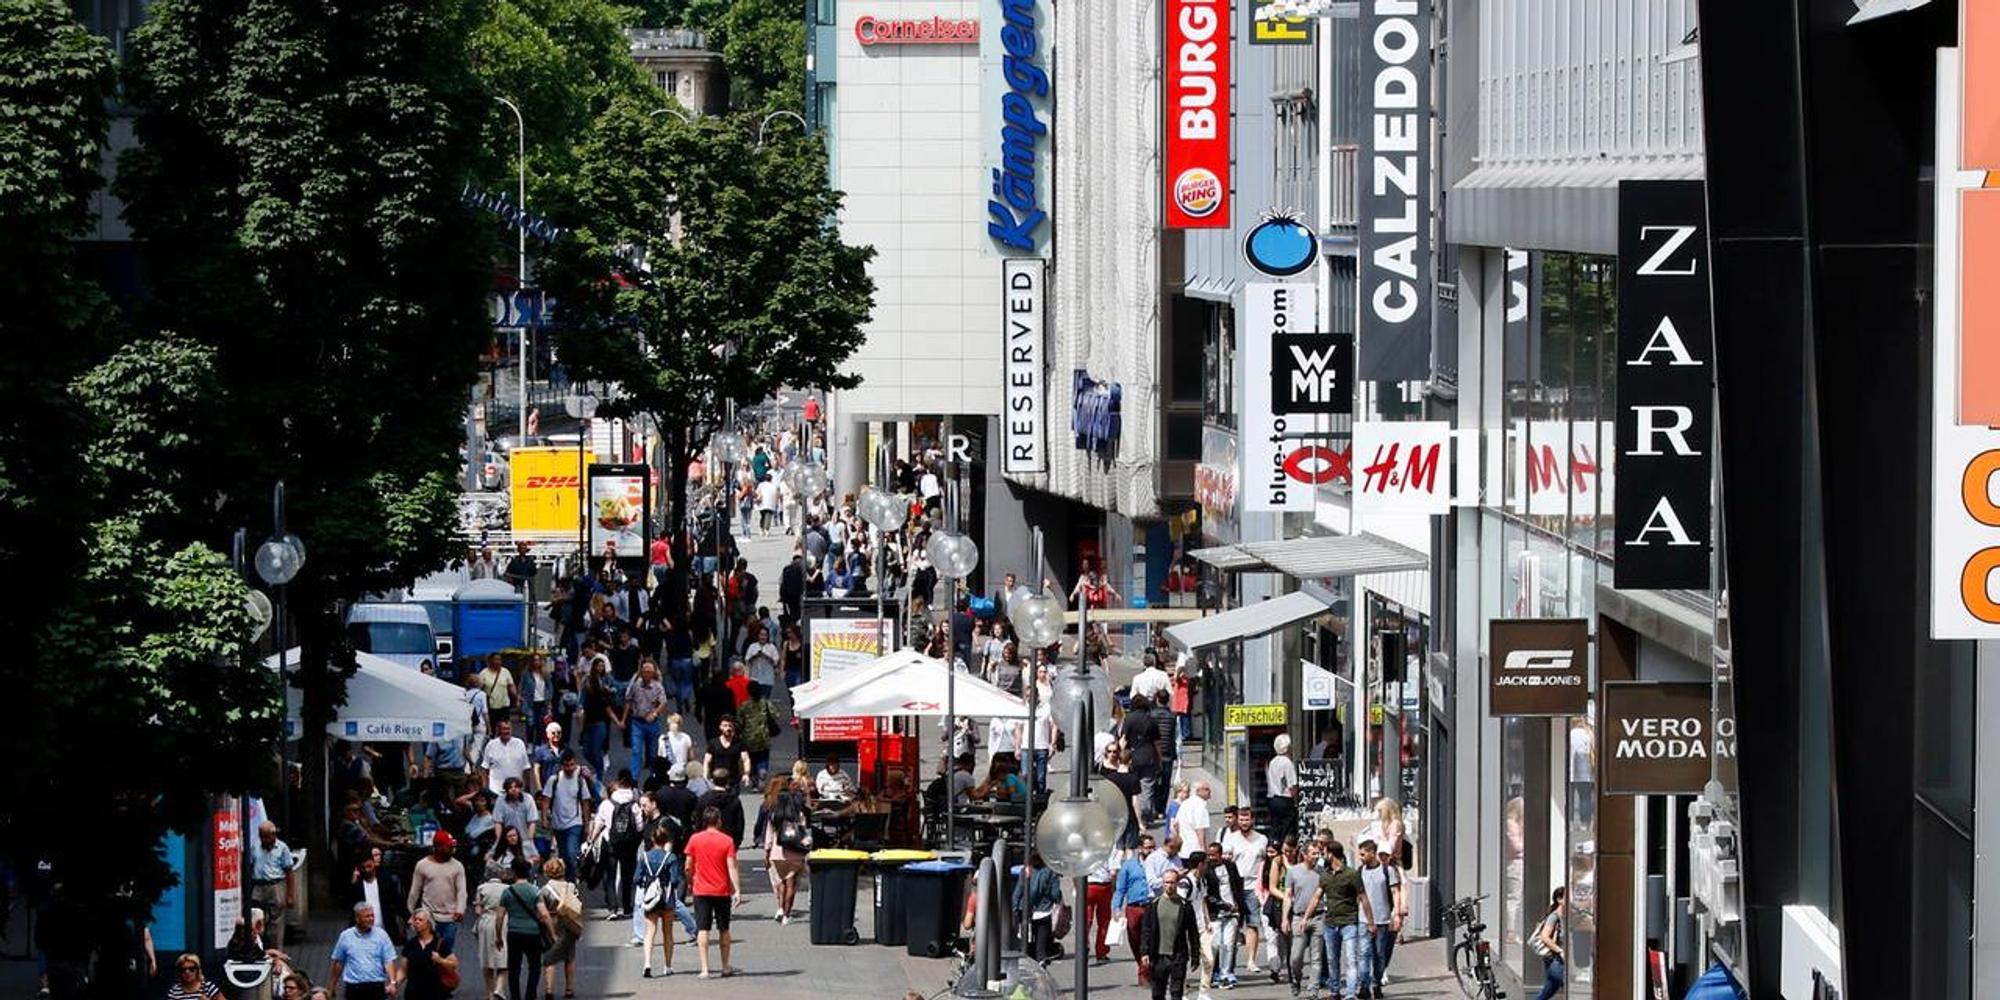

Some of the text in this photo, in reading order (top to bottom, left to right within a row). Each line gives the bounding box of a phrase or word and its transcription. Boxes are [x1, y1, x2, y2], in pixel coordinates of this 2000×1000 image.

[1179, 0, 1217, 140] BURG
[1181, 179, 1215, 193] BURGER
[1182, 187, 1216, 204] KING
[1012, 272, 1033, 461] RESERVED
[1289, 345, 1337, 403] WMF
[1625, 226, 1703, 545] ZARA
[948, 434, 972, 462] R
[1363, 443, 1440, 494] H&M
[527, 477, 580, 488] DHL
[1228, 708, 1282, 723] Fahrschule
[366, 723, 423, 736] Café Riese
[1621, 718, 1702, 737] VERO
[1616, 739, 1706, 758] MODA
